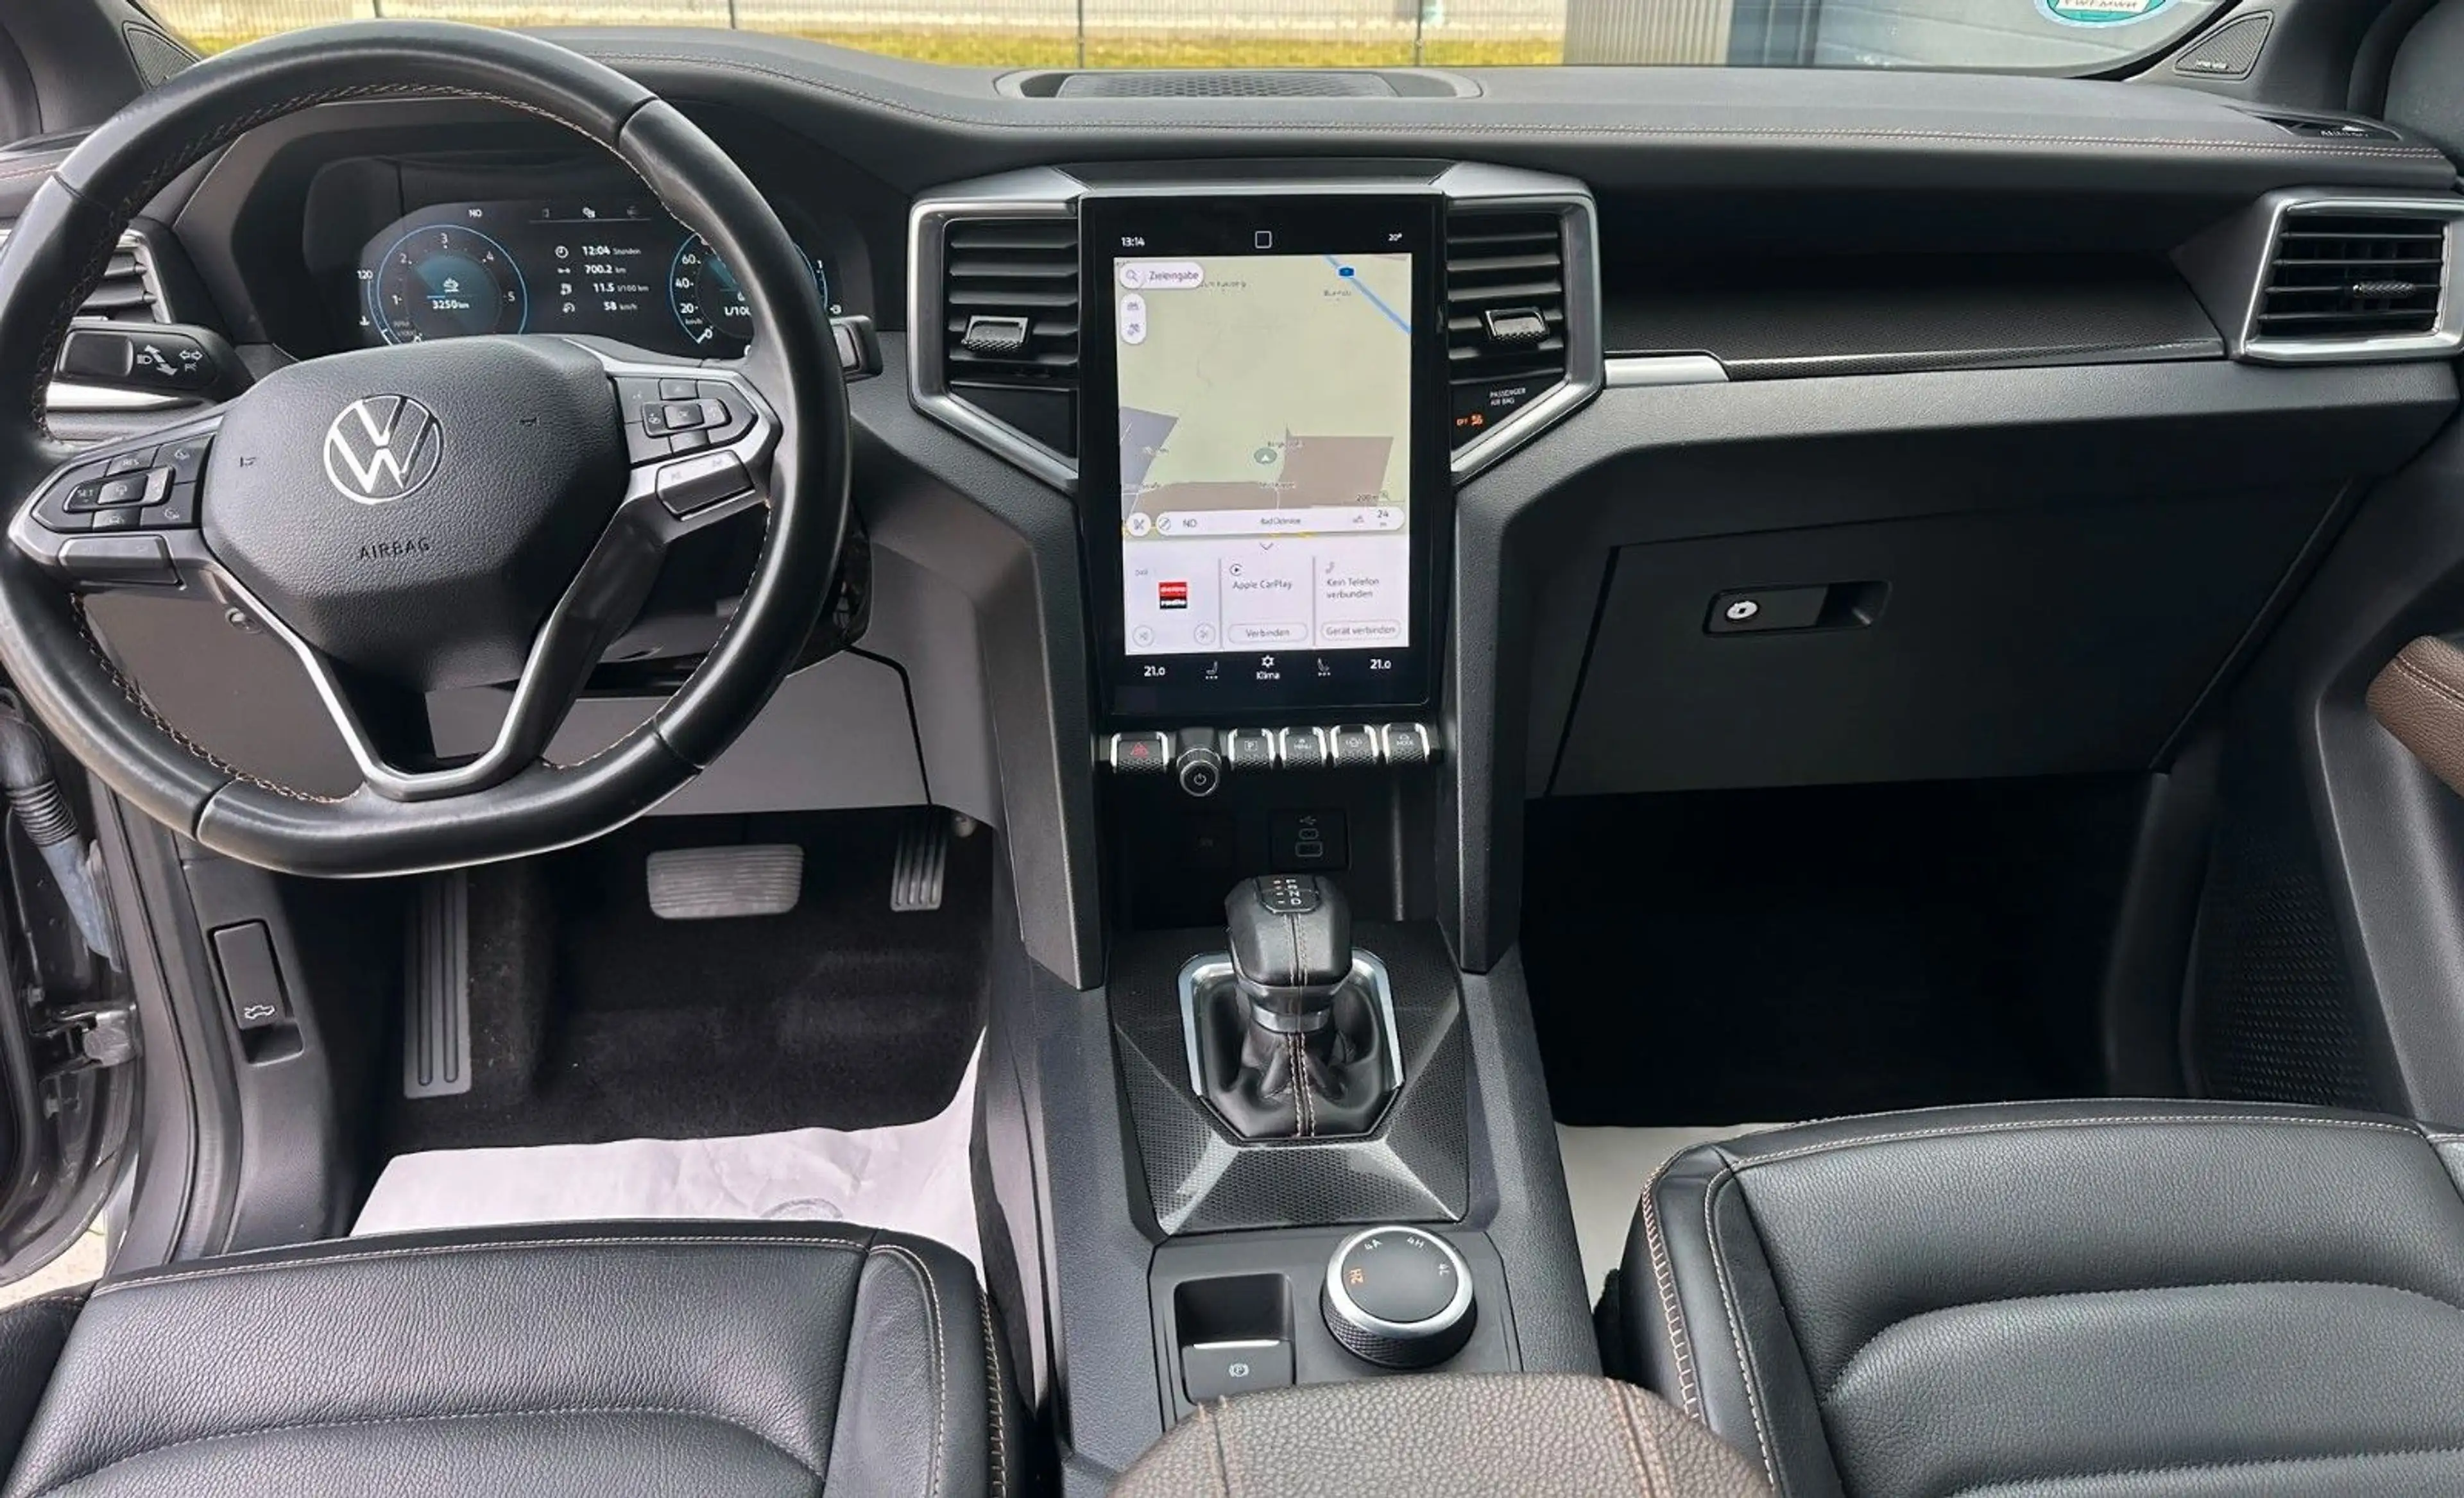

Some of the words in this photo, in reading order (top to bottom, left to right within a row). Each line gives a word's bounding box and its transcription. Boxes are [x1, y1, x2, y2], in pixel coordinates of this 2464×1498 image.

[441, 233, 448, 243] 3
[1122, 237, 1145, 247] 13:14
[486, 251, 493, 260] 4
[582, 246, 610, 256] 12:04
[400, 253, 407, 263] 2
[682, 255, 696, 264] 60
[585, 264, 613, 274] 700.2
[357, 270, 373, 280] 120
[1149, 270, 1199, 282] Zieleingabe
[593, 283, 615, 293] 11.5
[676, 278, 690, 288] 40
[603, 301, 617, 311] 58
[680, 303, 694, 314] 20
[1489, 387, 1526, 398] PASSENGER
[359, 536, 430, 561] AIRBAG
[1233, 580, 1258, 590] Apple
[1260, 579, 1293, 590] CarPlay
[1327, 577, 1346, 587] Kein
[1349, 577, 1380, 586] Telefon
[1326, 589, 1373, 599] verbunden
[1245, 628, 1290, 638] Verbinden
[1326, 626, 1350, 636] Gerät
[1353, 625, 1396, 635] verbinden
[1371, 658, 1392, 670] 21.0
[1144, 665, 1165, 677] 21.0
[1256, 670, 1281, 681] Klima
[1364, 1238, 1383, 1250] 4A
[1407, 1236, 1425, 1249] 4H
